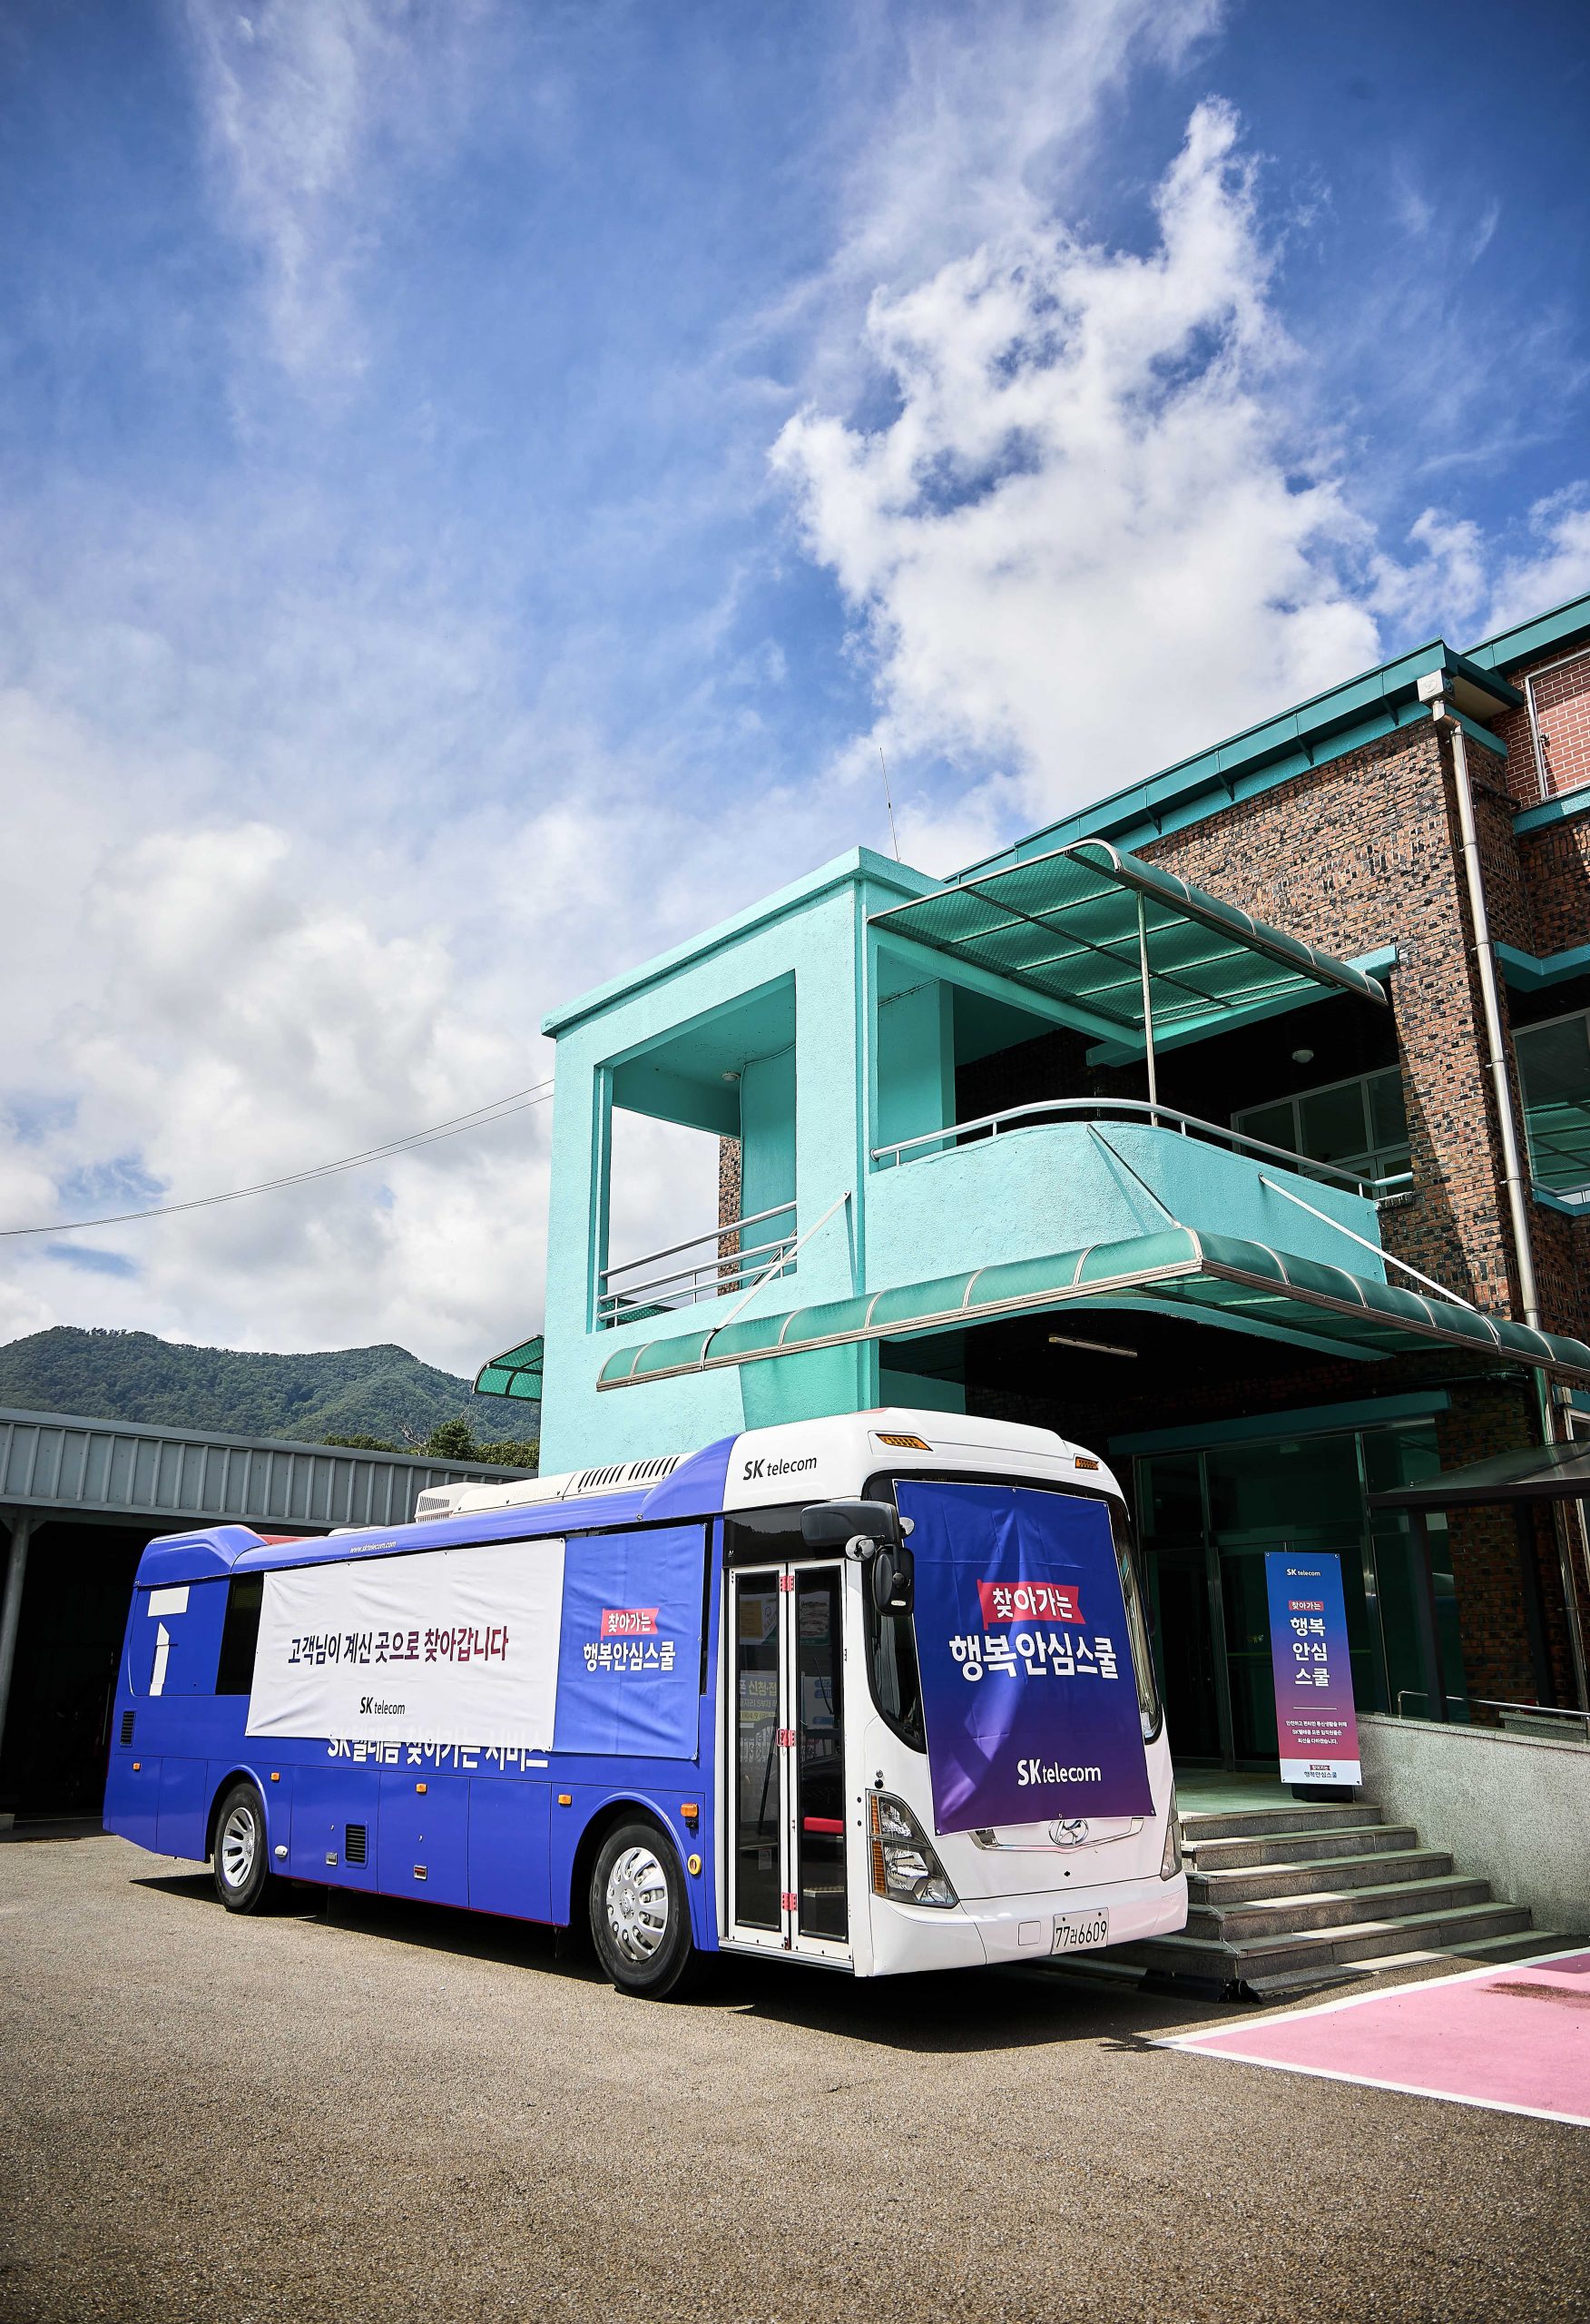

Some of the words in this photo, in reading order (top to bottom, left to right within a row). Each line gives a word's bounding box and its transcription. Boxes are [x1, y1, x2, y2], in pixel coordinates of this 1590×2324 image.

[742, 1459, 766, 1481] SK
[767, 1457, 818, 1476] telecom
[349, 1541, 397, 1553] www.sktelecom.com
[993, 1587, 1073, 1619] 찾아가는
[1291, 1601, 1321, 1610] 찾아가는
[608, 1612, 652, 1633] 찾아가는
[1291, 1618, 1326, 1637] 행복
[288, 1632, 341, 1665] 고객님이
[343, 1631, 372, 1663] 계신
[375, 1631, 419, 1663] 곳으로
[424, 1626, 509, 1662] 찾아갑니다
[583, 1641, 676, 1671] 행복안심스쿨
[1292, 1642, 1328, 1662] 안심
[1294, 1668, 1330, 1687] 스쿨
[359, 1696, 374, 1714] SK
[374, 1700, 406, 1715] telecom
[1016, 1759, 1041, 1787] SK
[1043, 1762, 1102, 1783] telecom
[1055, 1920, 1107, 1948] 77러6609
